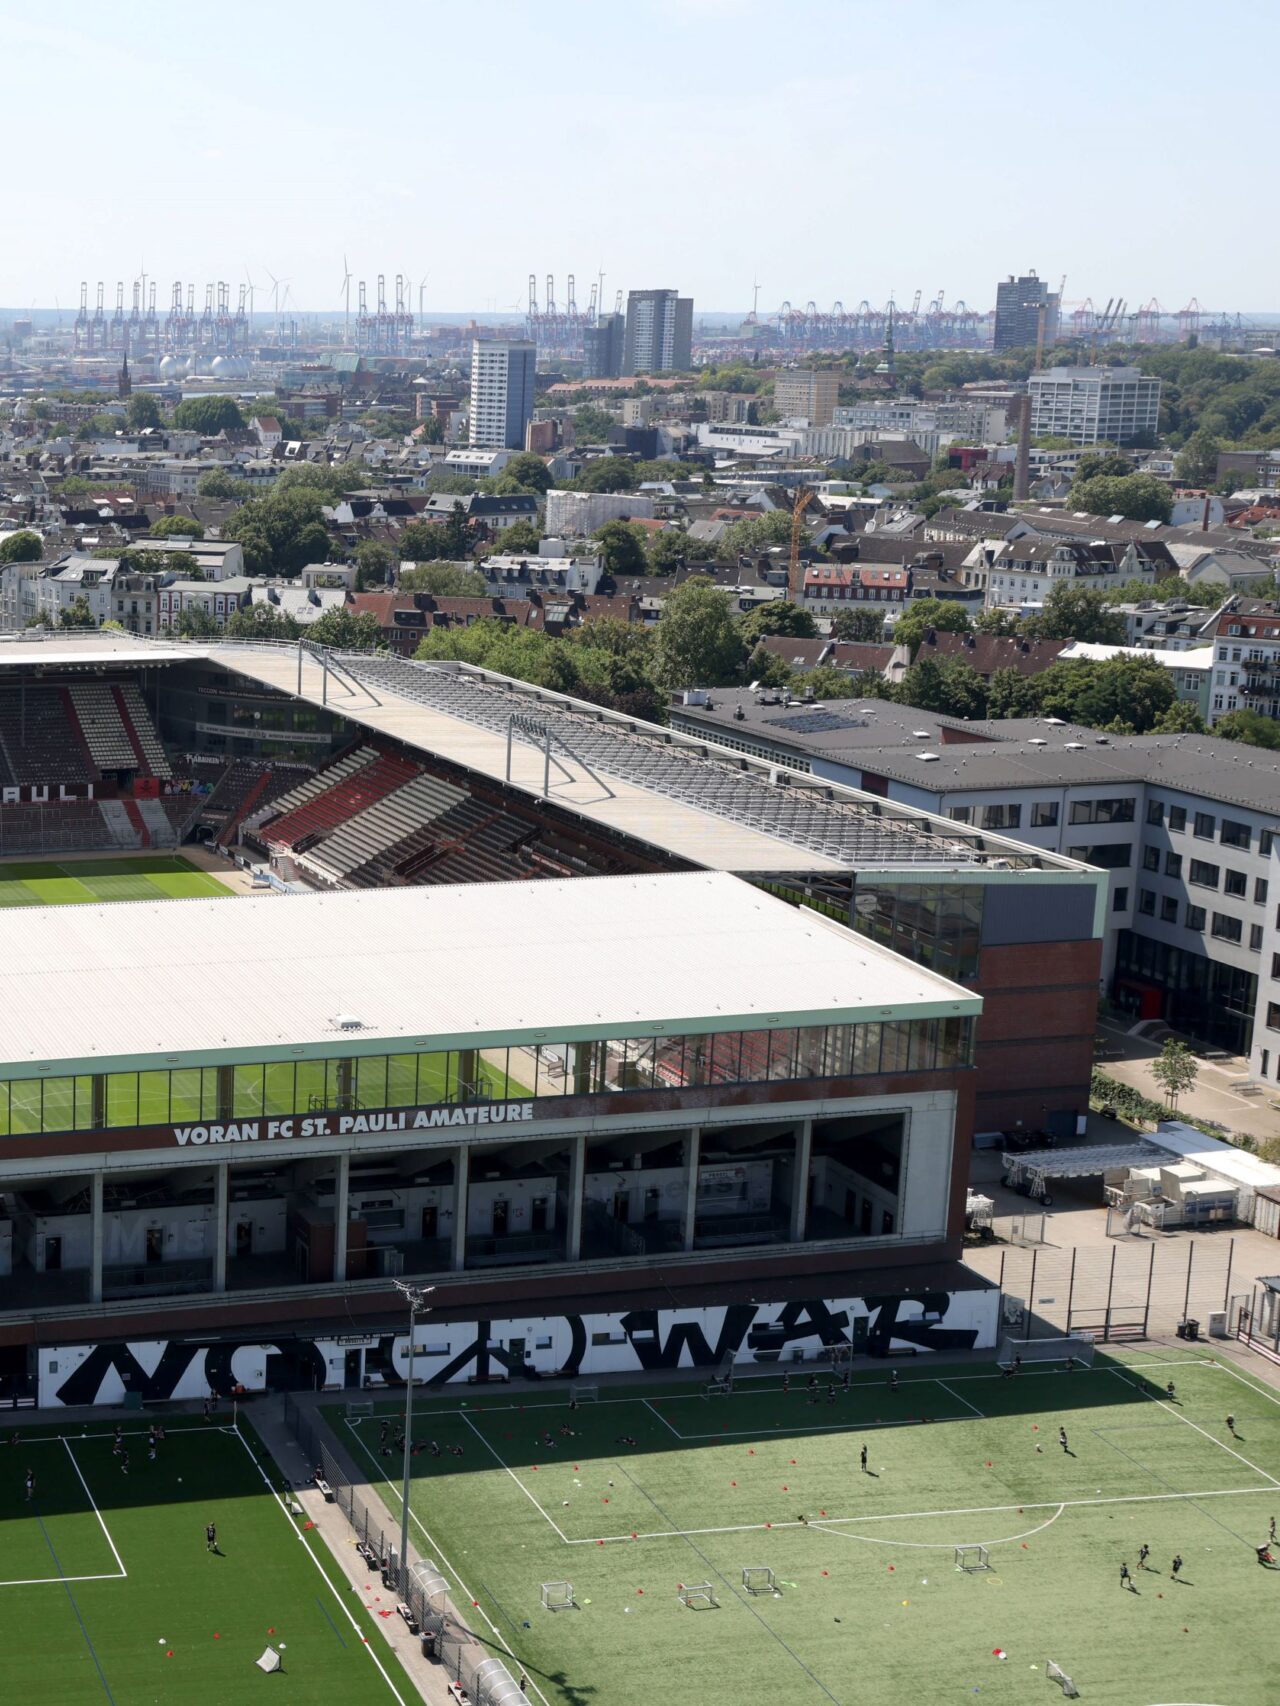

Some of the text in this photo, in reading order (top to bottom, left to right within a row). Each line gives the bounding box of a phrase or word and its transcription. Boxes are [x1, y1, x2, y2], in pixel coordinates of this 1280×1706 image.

[173, 1103, 533, 1146] VORAN FC ST. PAULI AMATEURE
